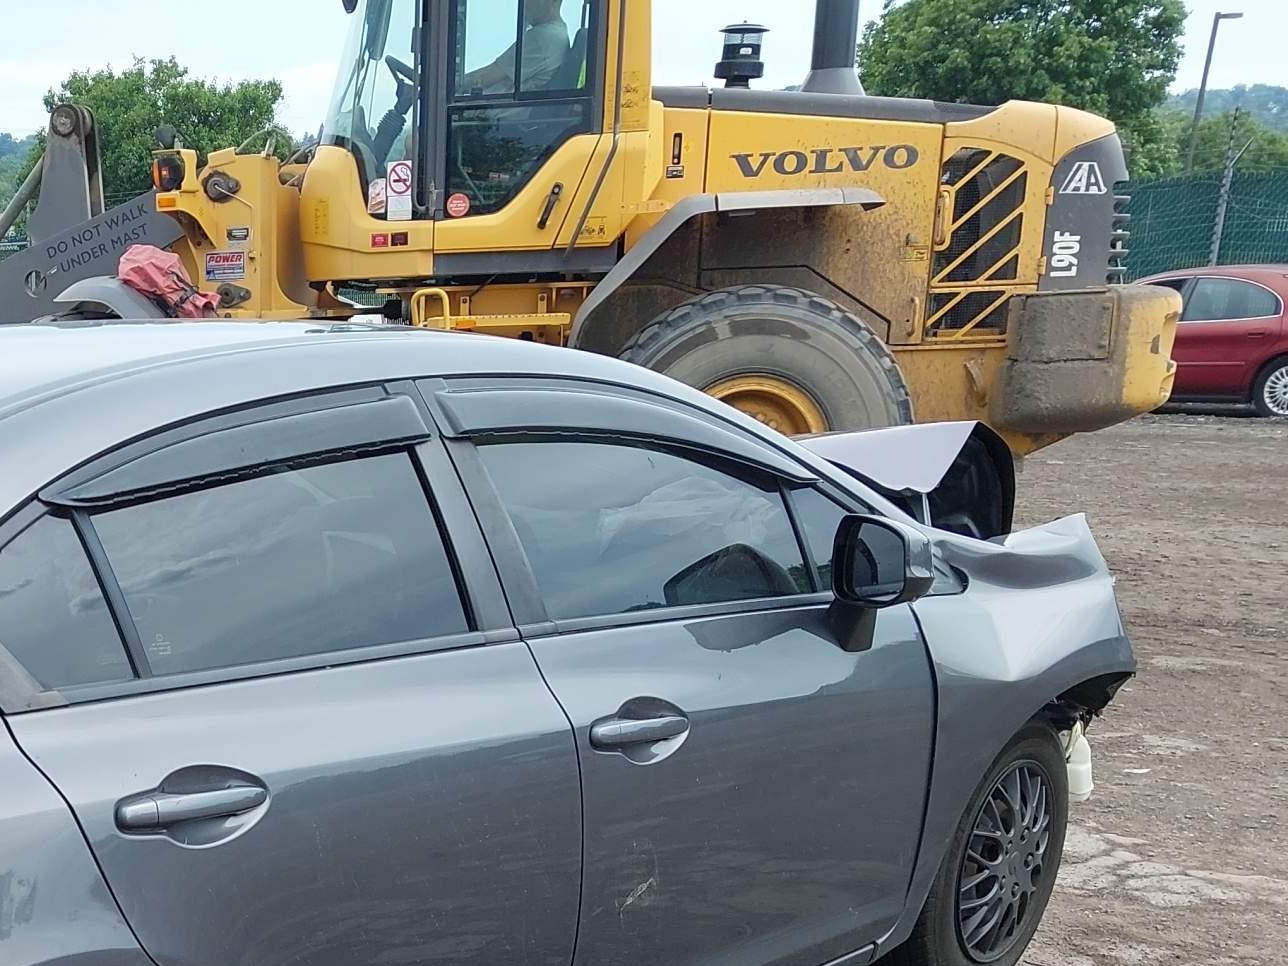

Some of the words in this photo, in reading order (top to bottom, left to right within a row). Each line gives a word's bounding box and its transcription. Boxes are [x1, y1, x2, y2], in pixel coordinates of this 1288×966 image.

[729, 144, 919, 178] VOLVO
[46, 241, 68, 259] DO
[72, 224, 101, 248] NOT
[104, 203, 148, 230] WALK
[60, 243, 109, 273] UNDER
[111, 223, 147, 250] MAST
[1050, 230, 1081, 277] L90F
[207, 254, 243, 264] POWER
